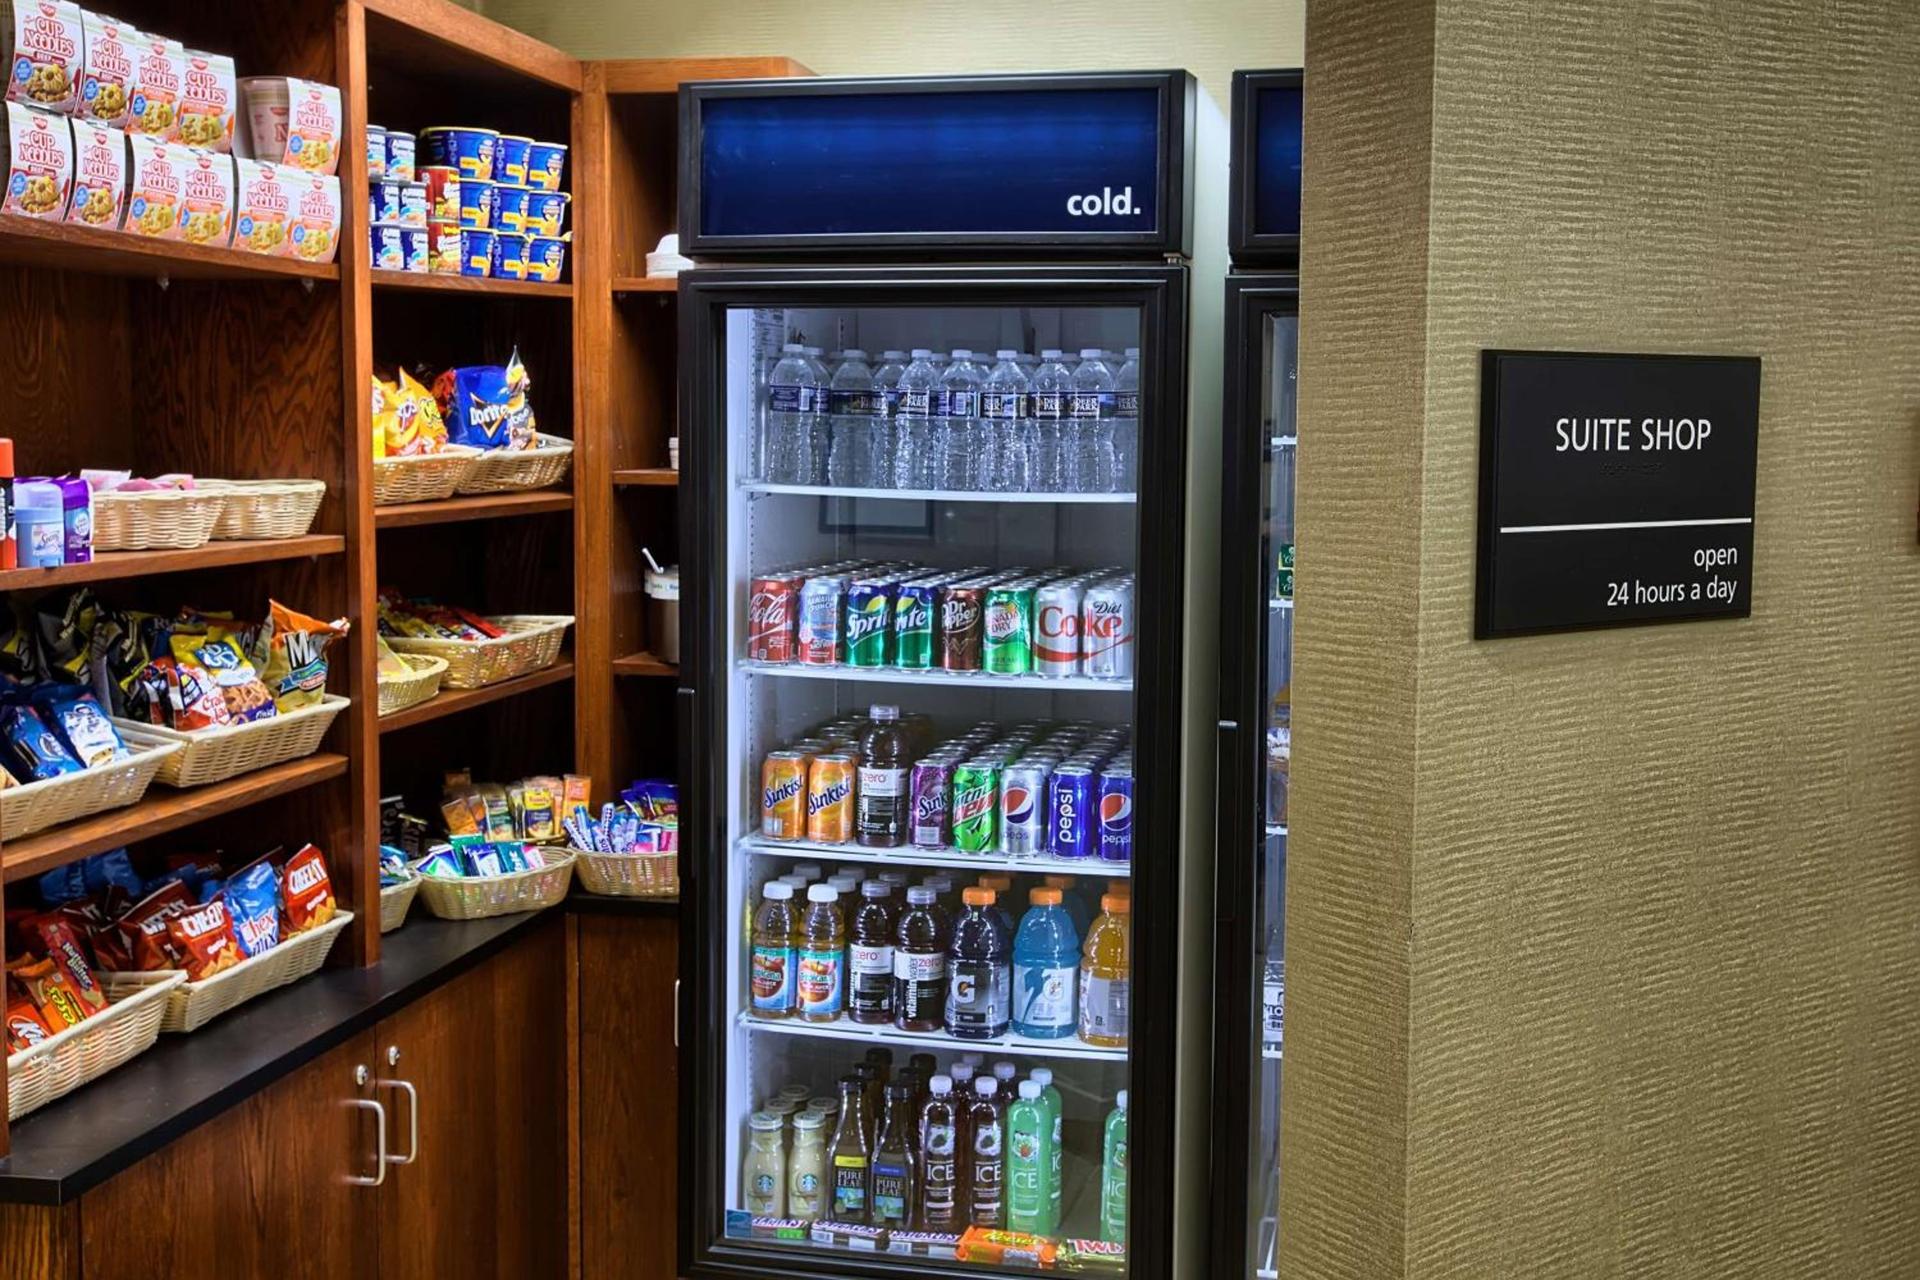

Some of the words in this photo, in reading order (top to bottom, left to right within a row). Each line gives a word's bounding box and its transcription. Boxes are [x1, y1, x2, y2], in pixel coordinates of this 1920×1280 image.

[36, 16, 64, 37] CUP
[23, 28, 75, 58] NOODLES
[101, 38, 123, 57] CUP
[91, 49, 132, 77] NOODLES
[149, 55, 171, 74] CUP
[185, 69, 217, 89] CUP
[184, 82, 228, 105] OODLES
[305, 100, 327, 118] CUP
[30, 131, 55, 149] CUP
[18, 143, 65, 169] NOODLES
[91, 146, 112, 162] CUP
[152, 160, 172, 176] CUP
[192, 170, 219, 187] CUP
[256, 181, 281, 198] CUP
[1066, 186, 1142, 216] cold.
[1556, 418, 1632, 452] SUITE
[1641, 418, 1712, 451] SHOP
[1694, 547, 1738, 572] open
[1607, 582, 1630, 607] 24
[1635, 580, 1685, 605] hours
[1690, 584, 1701, 600] a
[1706, 575, 1738, 603] day
[948, 600, 967, 615] Dr
[1093, 600, 1122, 614] Diet
[764, 774, 804, 809] Sunkist
[809, 776, 850, 816] Sunkist
[919, 791, 949, 821] Sunk
[1058, 788, 1076, 844] pepsi
[1102, 834, 1132, 846] pepsi
[240, 911, 275, 944] Chex
[62, 941, 88, 970] Nutter
[1052, 1151, 1062, 1171] IC
[838, 1170, 863, 1180] PURE
[927, 1165, 954, 1181] ICE
[975, 1165, 1001, 1182] ICE
[1013, 1171, 1038, 1189] ICE
[877, 1178, 902, 1189] PURE
[1111, 1180, 1126, 1198] IC
